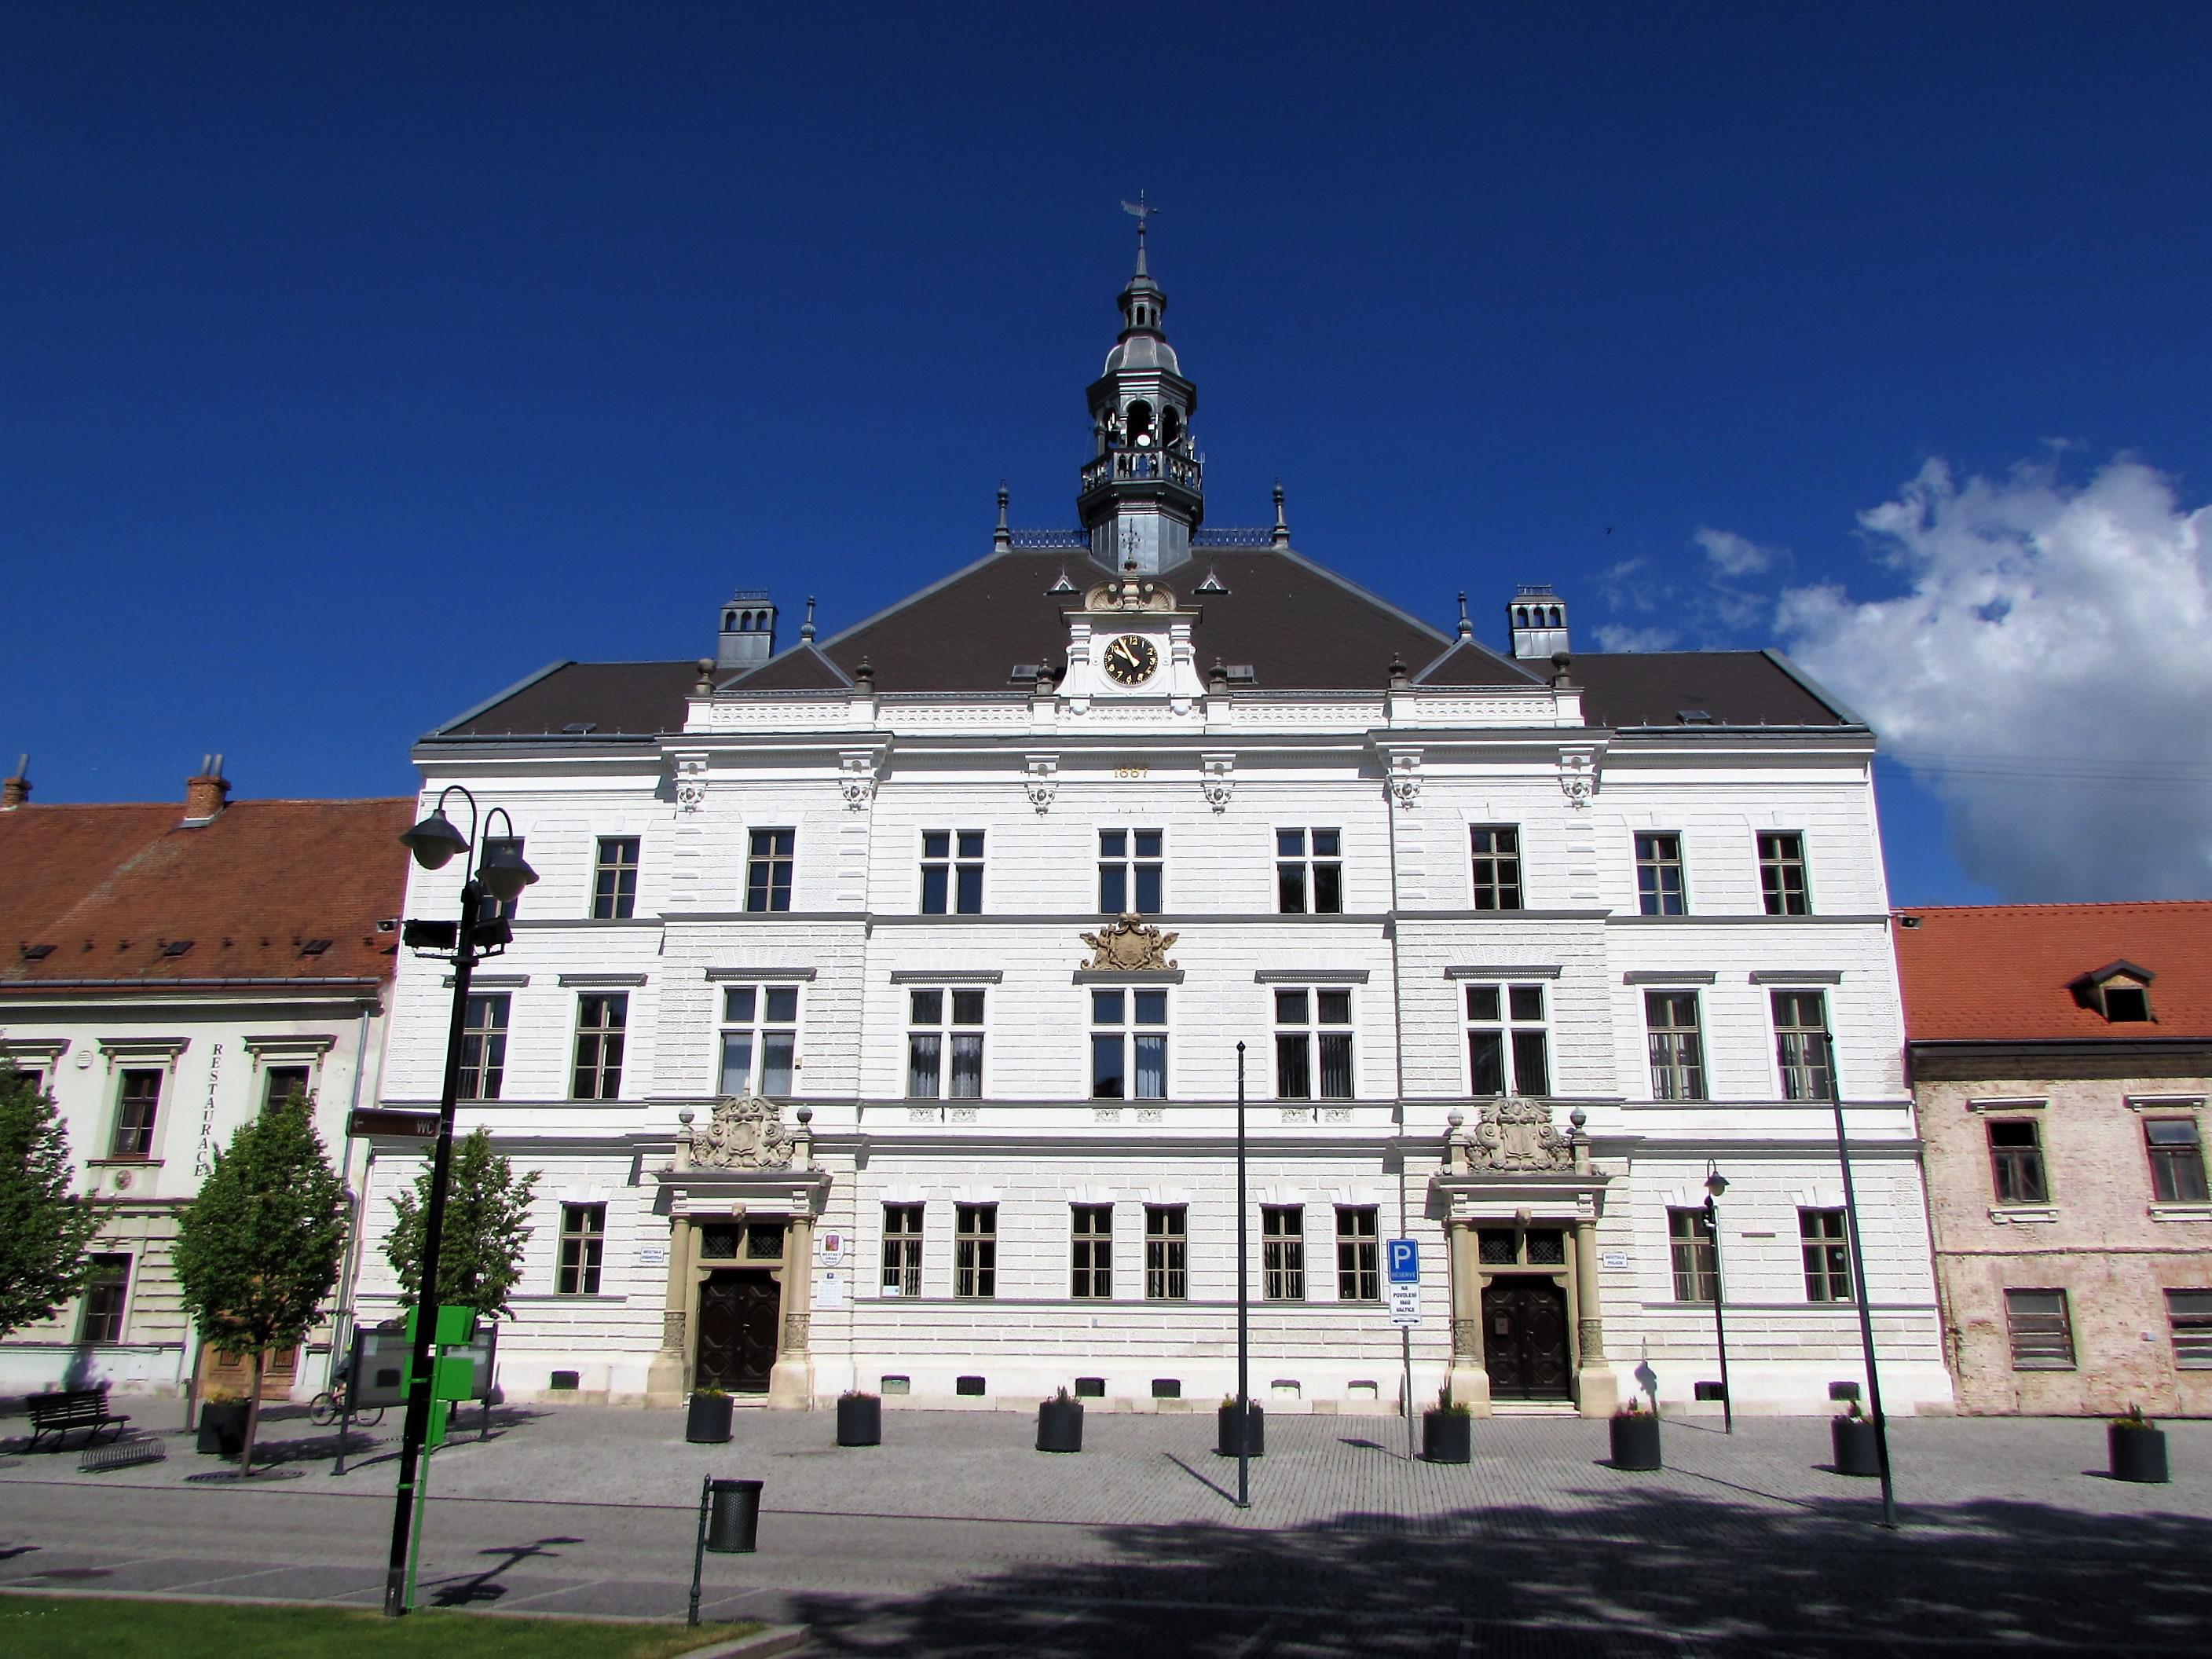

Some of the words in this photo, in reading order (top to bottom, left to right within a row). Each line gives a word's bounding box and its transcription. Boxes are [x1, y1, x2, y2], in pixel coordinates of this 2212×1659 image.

[1130, 636, 1138, 646] 12
[1111, 644, 1119, 653] 10
[1147, 647, 1153, 656] 2
[1149, 657, 1155, 665] 3
[1116, 670, 1123, 679] 7
[1126, 674, 1132, 683] 6
[194, 1043, 224, 1177] RESTAURACE
[416, 1119, 434, 1134] WC
[1393, 1245, 1412, 1269] P
